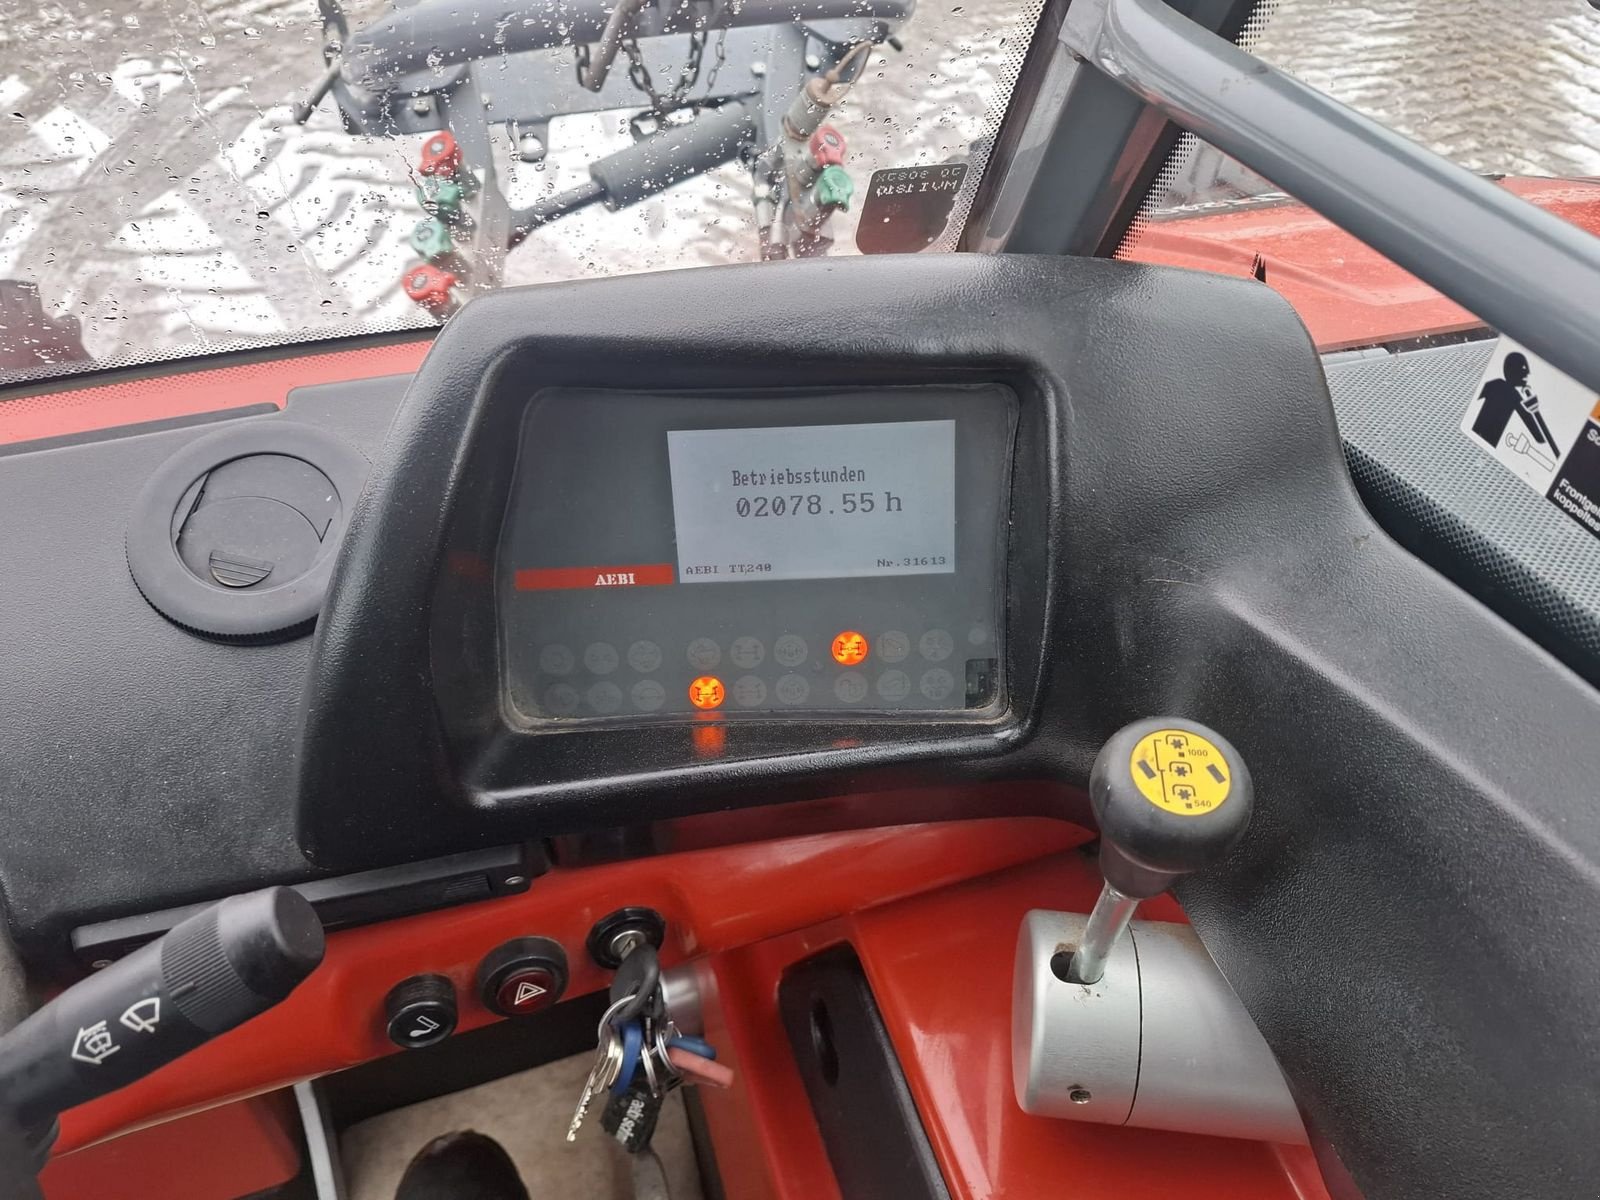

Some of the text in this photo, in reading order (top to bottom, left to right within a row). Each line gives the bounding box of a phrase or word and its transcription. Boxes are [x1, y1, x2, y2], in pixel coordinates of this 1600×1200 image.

[732, 466, 865, 486] Betriebsstunden
[736, 491, 903, 517] 02078.55 h
[685, 565, 720, 575] AEBI
[595, 573, 635, 586] AEBI
[1187, 748, 1209, 757] 1000
[1194, 800, 1212, 808] 540
